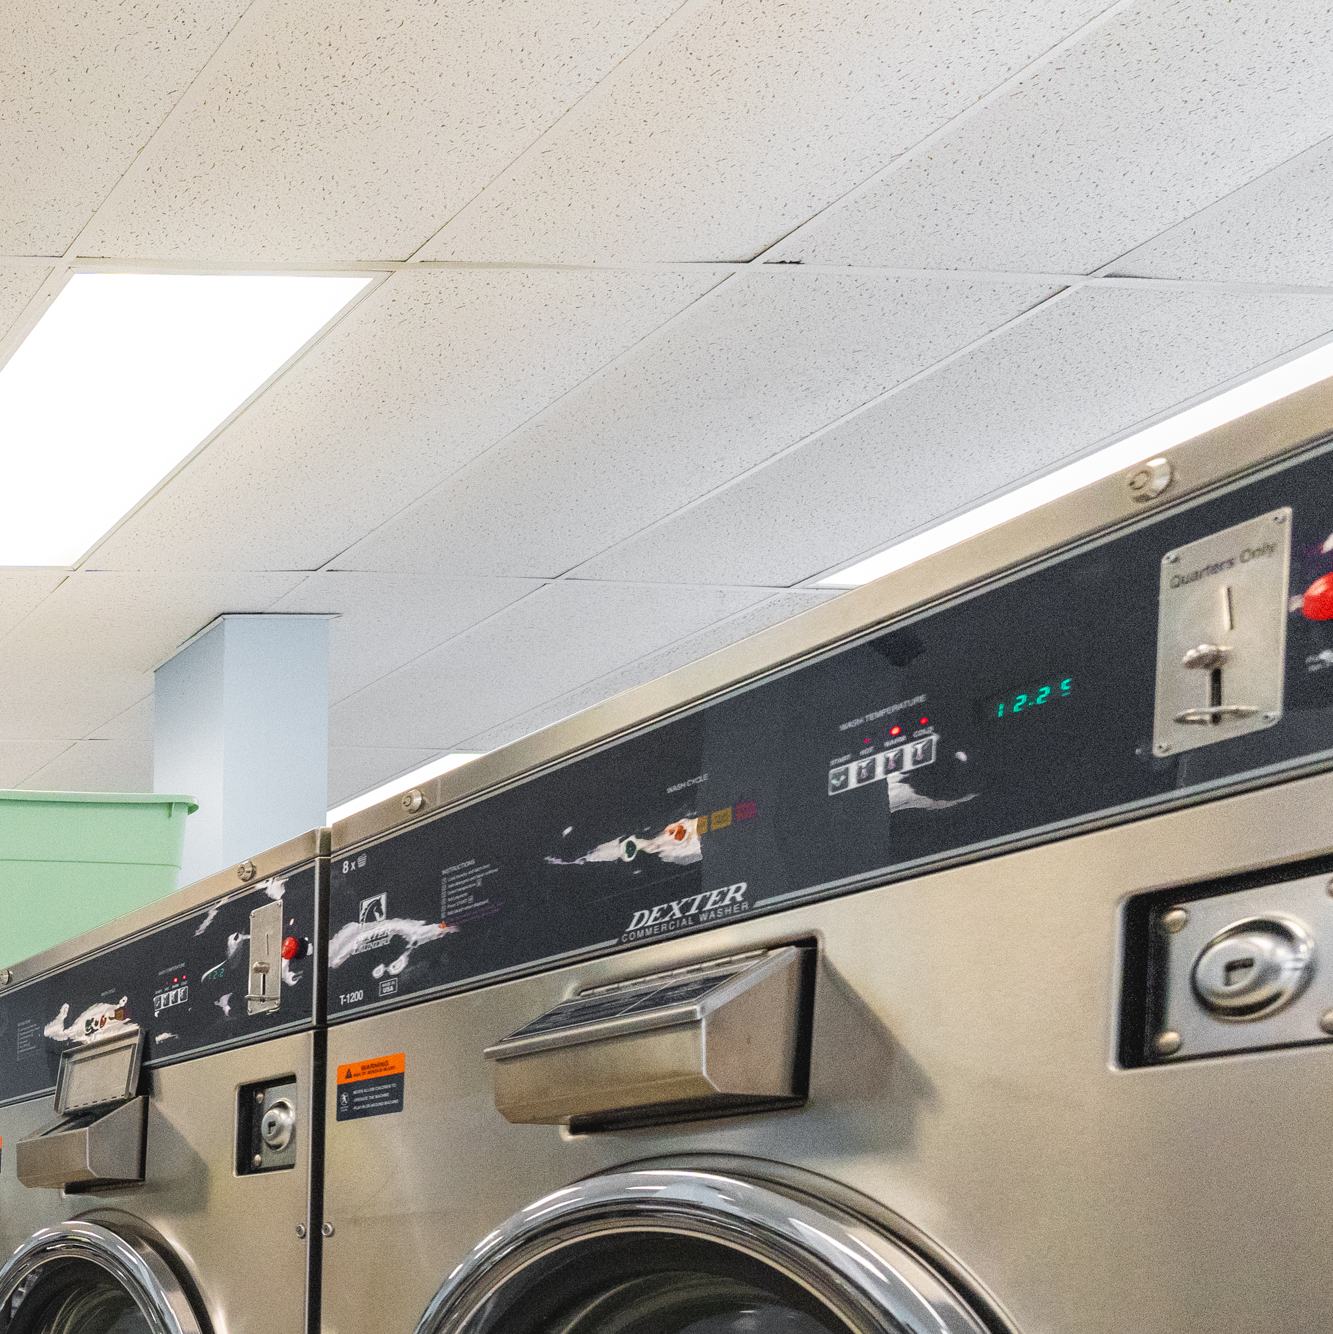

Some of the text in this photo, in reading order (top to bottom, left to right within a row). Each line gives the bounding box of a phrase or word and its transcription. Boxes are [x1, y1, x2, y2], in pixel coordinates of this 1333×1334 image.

[1170, 543, 1277, 589] Quarters Only
[839, 694, 926, 731] WASH TEMPERATURE
[667, 774, 708, 794] WASH CYCLE
[342, 861, 356, 873] 8 x
[625, 882, 747, 931] DEXTER
[621, 902, 749, 942] COMMERCIAL WASHER
[339, 990, 364, 1005] T-1200
[361, 1060, 389, 1071] WARNING
